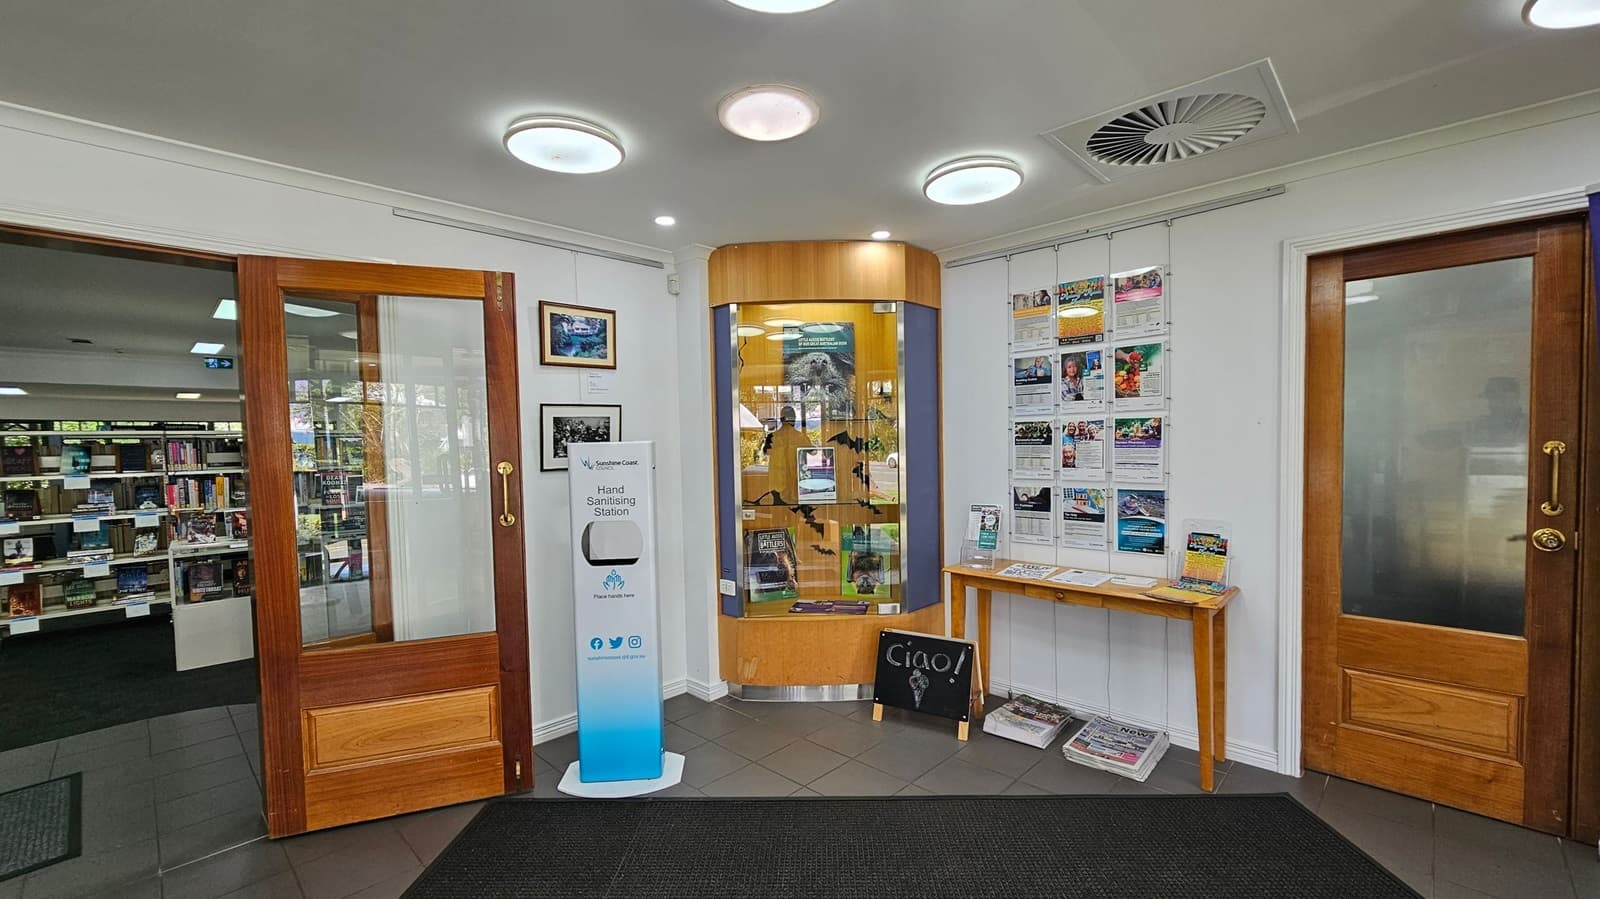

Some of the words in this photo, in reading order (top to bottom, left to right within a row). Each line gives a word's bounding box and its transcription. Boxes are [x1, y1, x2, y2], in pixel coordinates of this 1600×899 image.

[597, 485, 625, 495] Hand
[587, 496, 637, 507] Sanitising
[594, 507, 630, 517] Station
[886, 641, 966, 684] Ciao!
